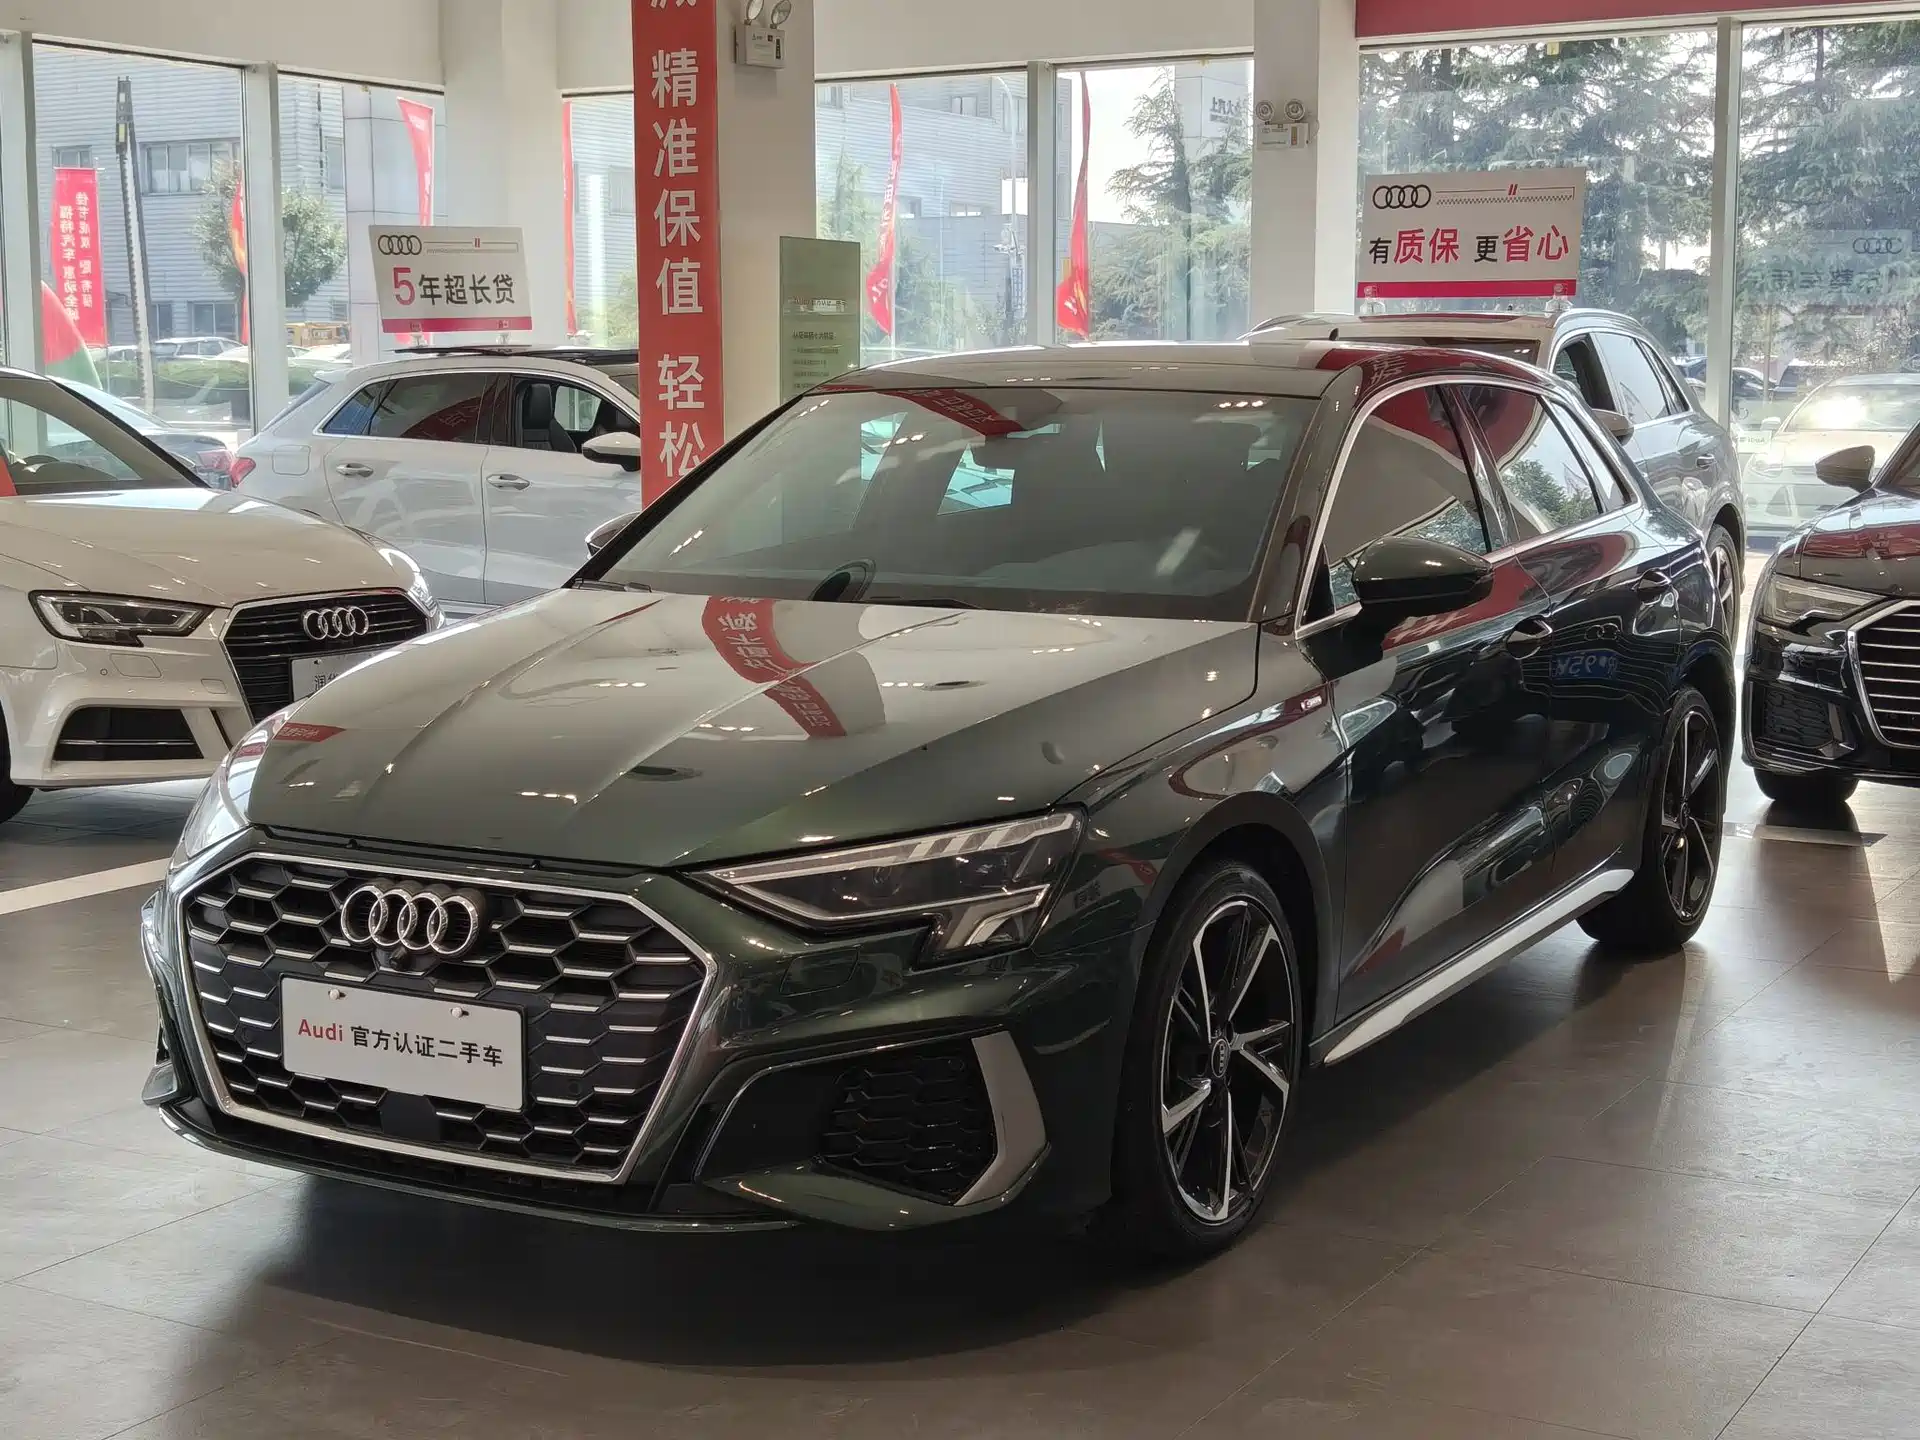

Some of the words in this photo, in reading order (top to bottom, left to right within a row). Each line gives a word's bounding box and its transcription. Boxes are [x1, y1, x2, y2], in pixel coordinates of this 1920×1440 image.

[651, 48, 704, 317] 精准保值
[1369, 227, 1460, 265] 有质保
[1474, 224, 1569, 264] 更省心
[393, 266, 515, 306] 5年超长贷
[658, 353, 705, 479] 轻松
[298, 1018, 344, 1042] Audi
[350, 1025, 504, 1068] 官方认证二手车
